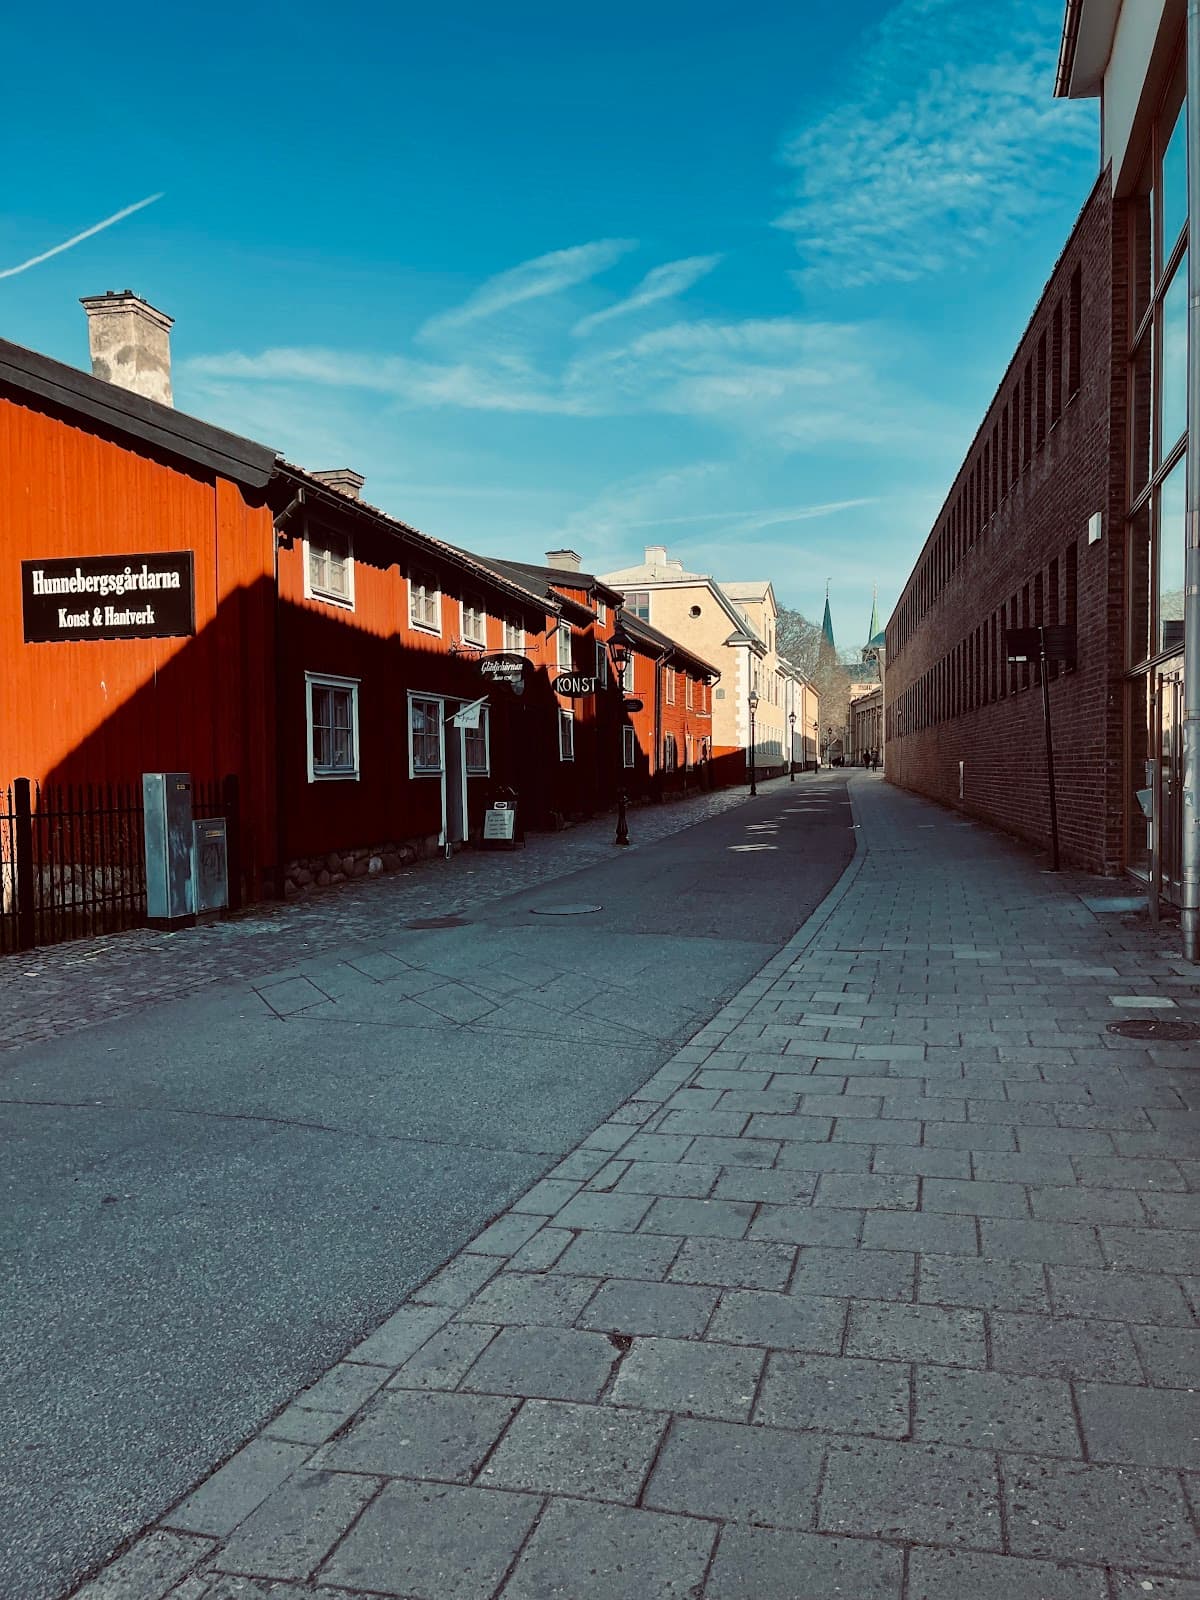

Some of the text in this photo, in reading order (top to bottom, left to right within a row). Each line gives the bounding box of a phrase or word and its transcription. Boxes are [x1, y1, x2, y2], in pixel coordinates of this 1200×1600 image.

[32, 565, 181, 596] Hunnebergsgårdarna
[58, 605, 155, 628] Konst & Hantverk
[556, 677, 597, 693] KONST
